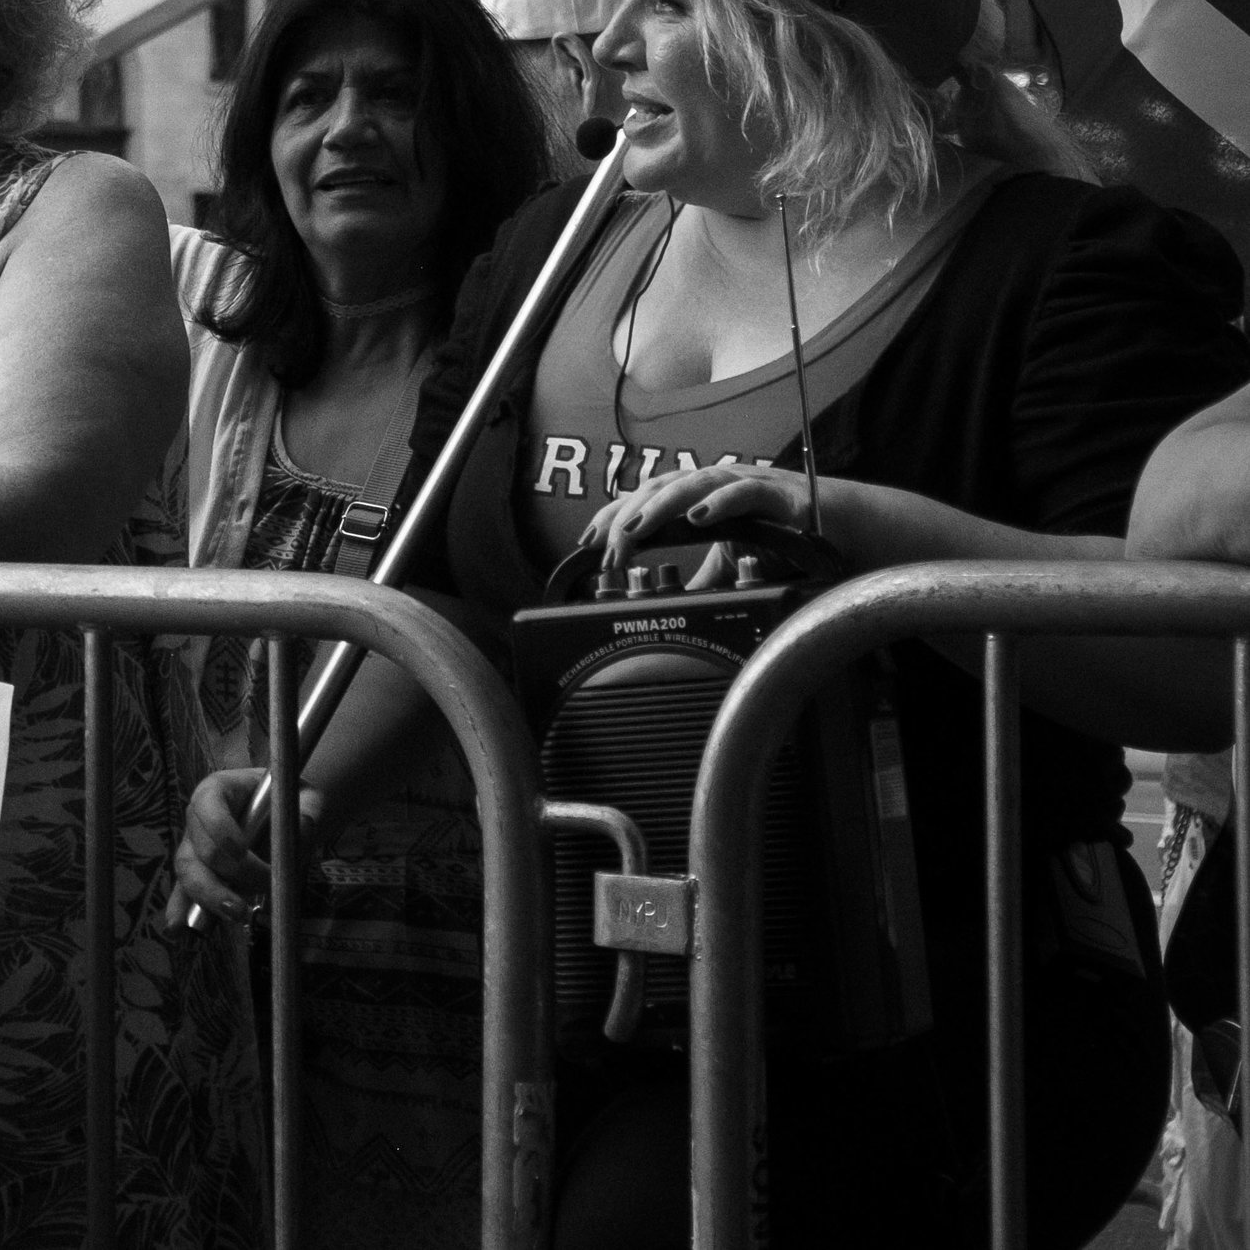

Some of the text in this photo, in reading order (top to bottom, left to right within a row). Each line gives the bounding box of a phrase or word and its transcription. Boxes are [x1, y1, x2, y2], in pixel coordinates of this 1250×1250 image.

[613, 616, 687, 635] PWMA200
[558, 643, 614, 688] RECHARGEABLE
[615, 633, 660, 649] PORTABLE
[663, 633, 708, 649] WIRELESS
